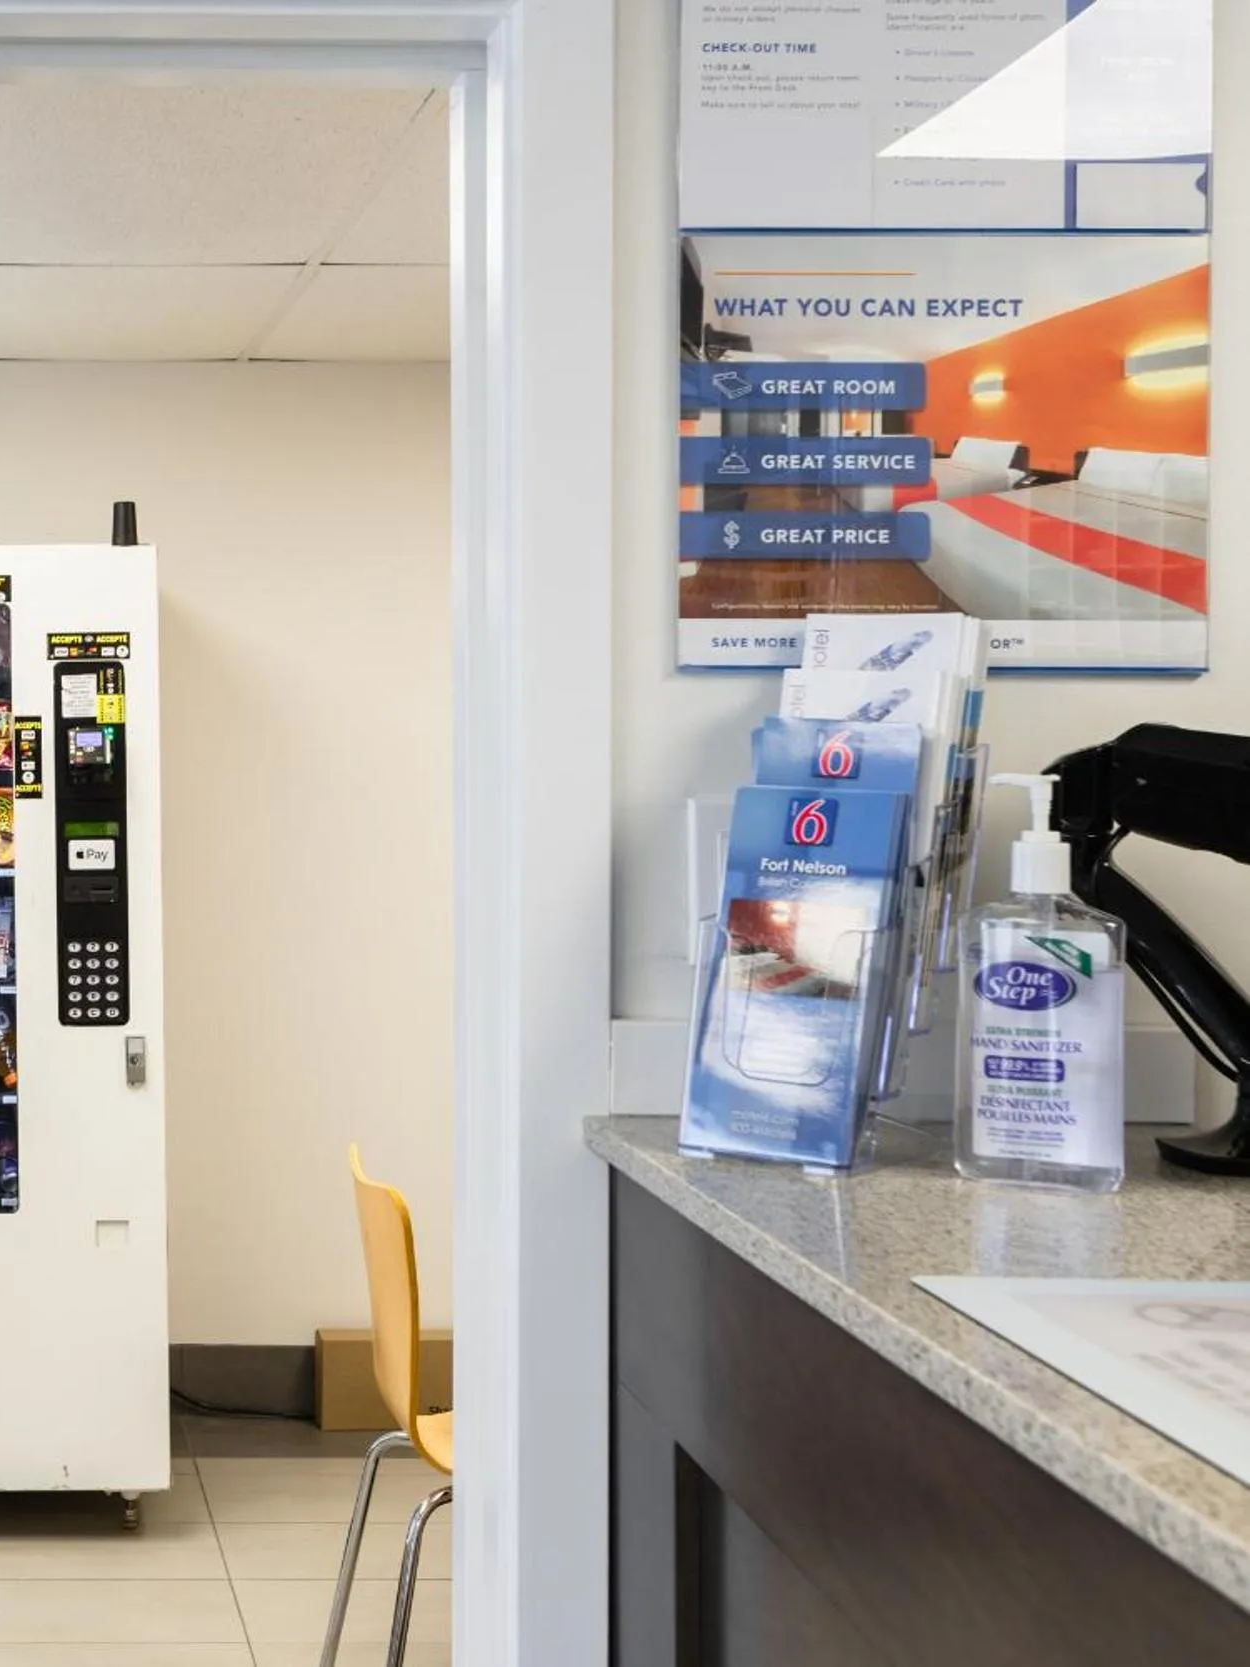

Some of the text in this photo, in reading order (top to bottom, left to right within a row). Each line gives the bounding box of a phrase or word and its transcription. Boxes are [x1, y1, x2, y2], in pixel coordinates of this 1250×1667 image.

[785, 43, 818, 54] TIME
[713, 298, 1023, 318] WHAT YOU CAN EXPECT
[761, 379, 896, 395] GREAT ROOM
[761, 454, 916, 470] GREAT SERVICE
[760, 529, 890, 545] GREAT PRICE
[712, 637, 748, 649] SAVE
[754, 637, 798, 649] MORE
[818, 728, 854, 777] 6
[791, 797, 828, 845] 6
[86, 849, 109, 863] Pay
[760, 857, 847, 876] Fort Nelson
[1006, 965, 1054, 986] One
[985, 975, 1037, 1006] Step
[970, 1036, 1083, 1053] HAND SANITZER
